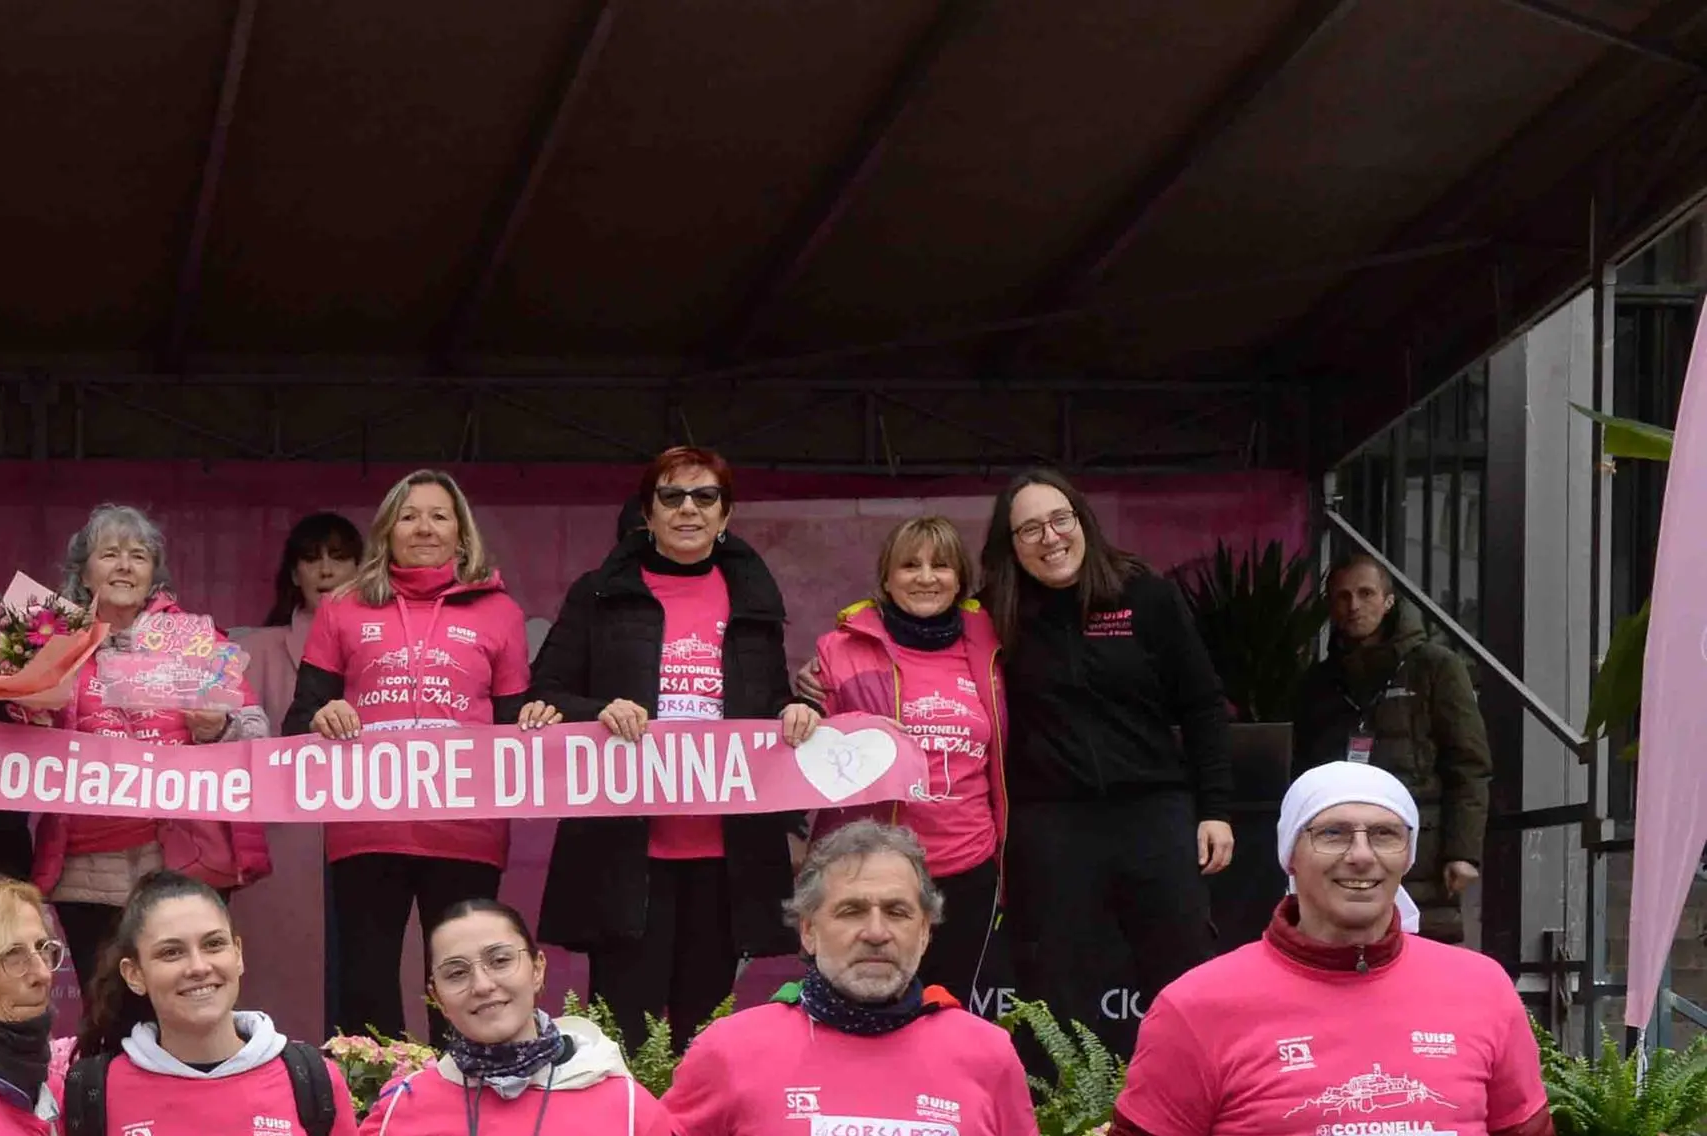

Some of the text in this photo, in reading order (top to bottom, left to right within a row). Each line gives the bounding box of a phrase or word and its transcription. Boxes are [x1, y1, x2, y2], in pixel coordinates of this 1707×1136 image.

[1103, 609, 1133, 620] UISP
[152, 614, 214, 636] CORSA
[184, 634, 214, 657] 26
[452, 694, 470, 711] 26
[969, 742, 986, 760] 26
[494, 736, 546, 807] DI
[1424, 1031, 1455, 1044] UISP
[930, 1095, 960, 1111] UISP
[265, 1117, 292, 1129] UISP
[1331, 1120, 1434, 1136] COTONELLA
